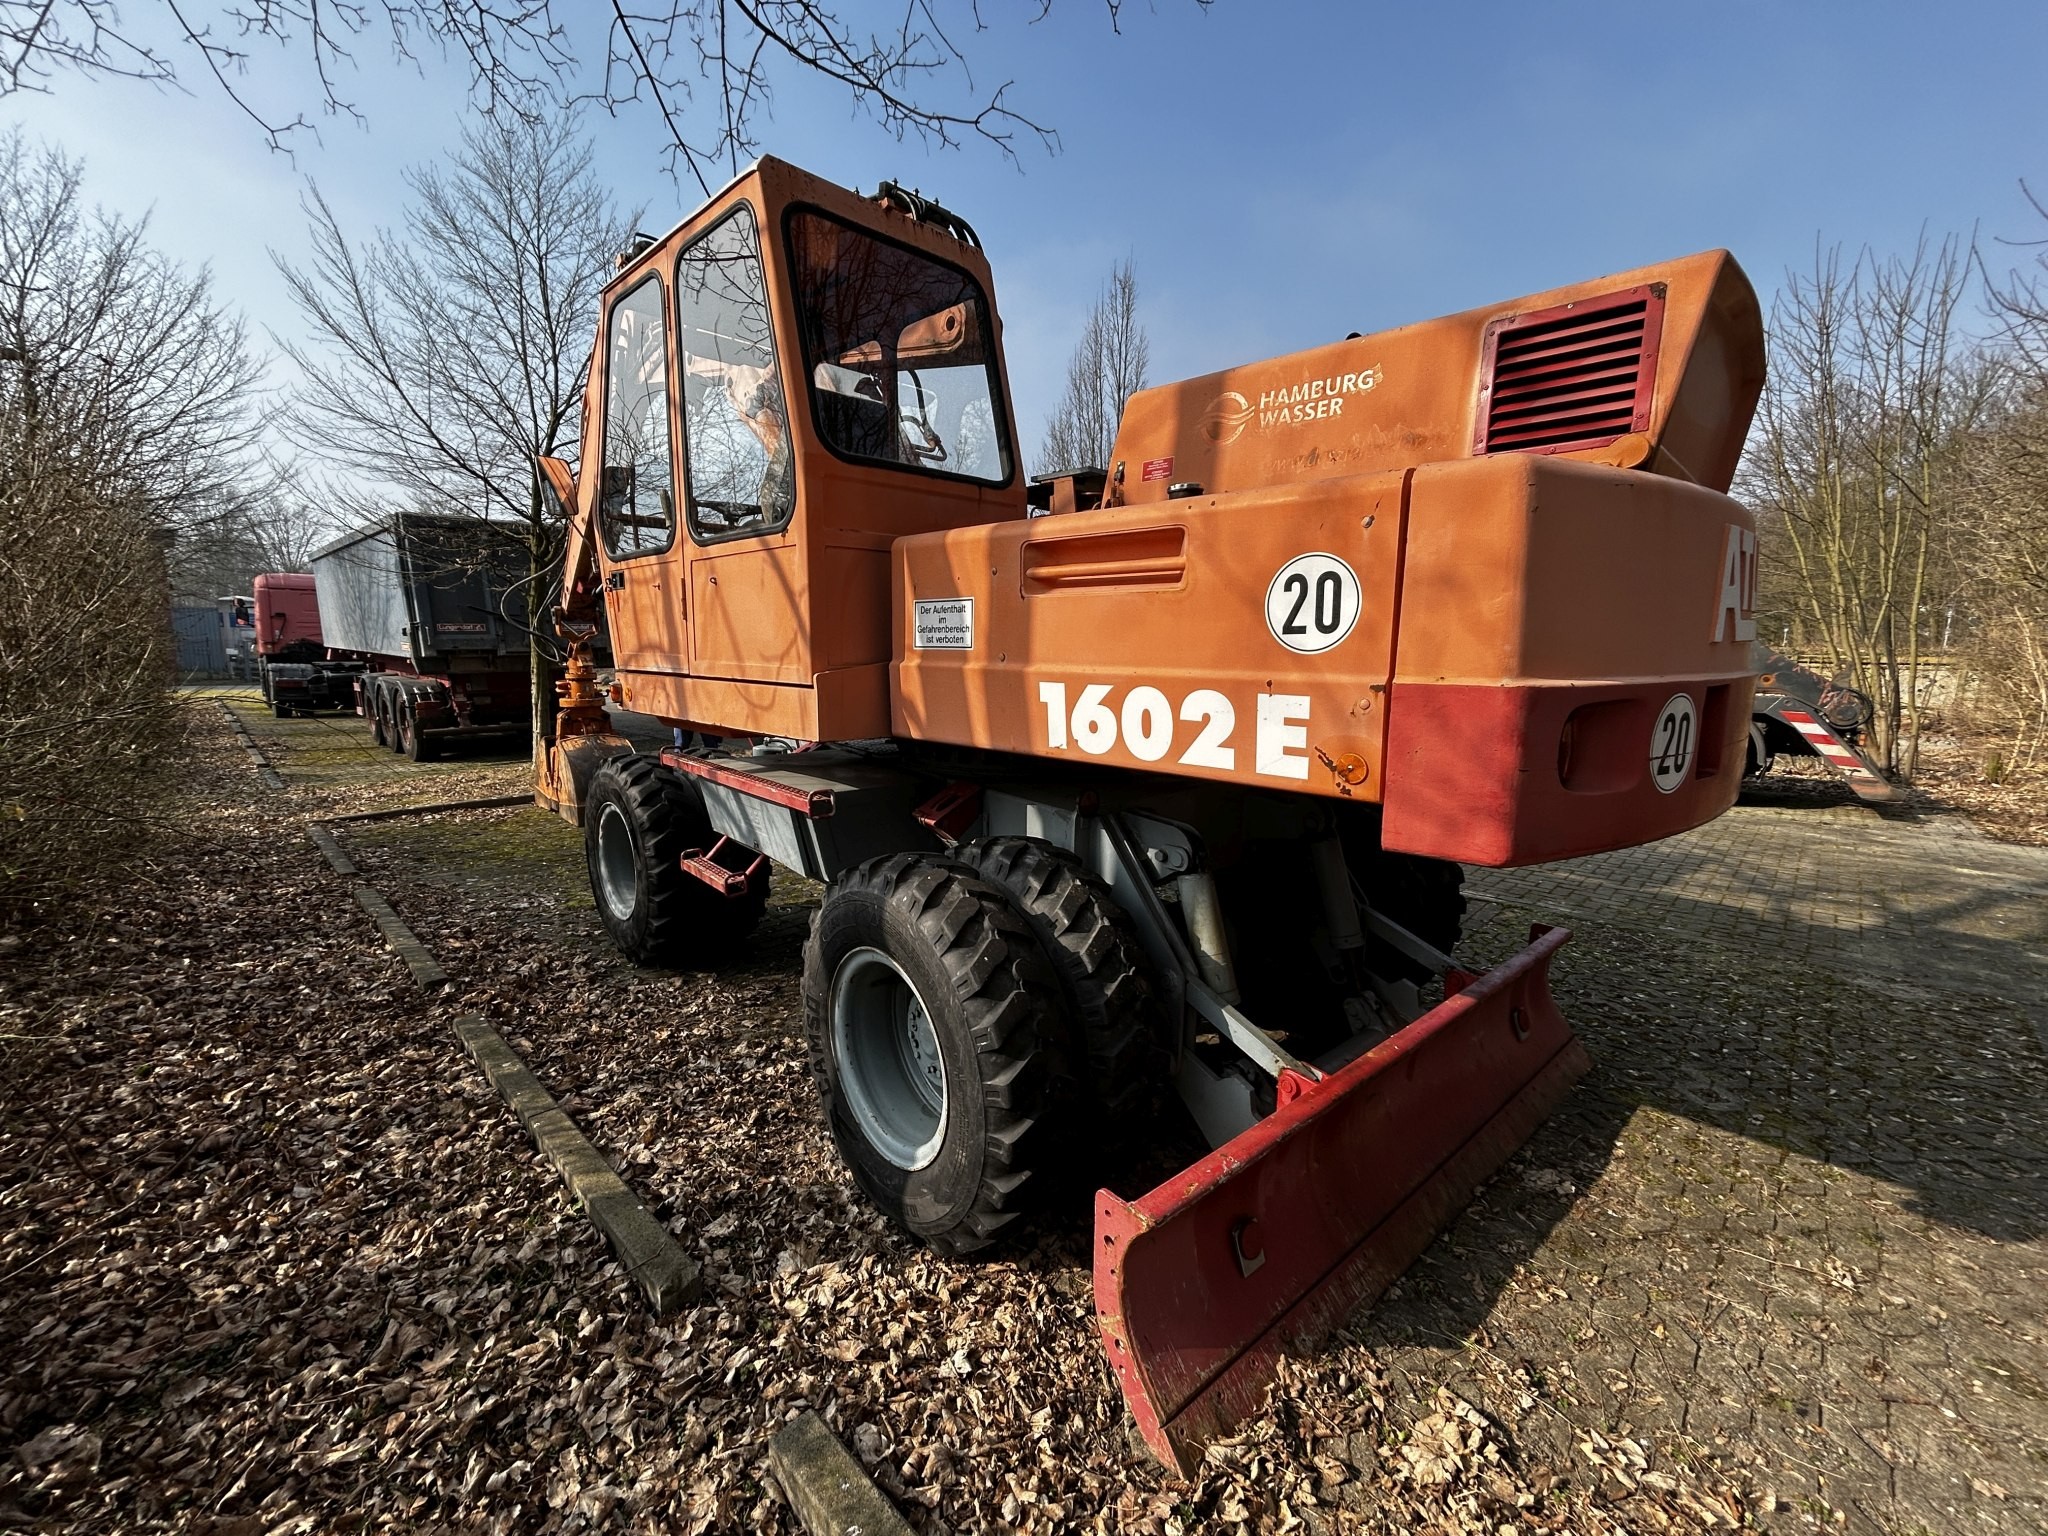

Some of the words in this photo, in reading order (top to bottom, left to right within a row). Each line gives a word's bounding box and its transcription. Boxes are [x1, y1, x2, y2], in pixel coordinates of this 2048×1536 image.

[1260, 370, 1374, 409] HAMBURG
[1260, 398, 1344, 428] WASSER
[920, 606, 931, 614] Der
[933, 604, 966, 614] Aufenthalt
[938, 615, 947, 624] im
[1282, 571, 1342, 635] 20
[917, 624, 970, 633] Gefahrenbereich
[926, 635, 934, 643] ist
[936, 635, 964, 643] verboten
[1039, 681, 1235, 771] 1602
[1255, 693, 1311, 780] E
[1656, 712, 1691, 776] 20
[805, 992, 832, 1097] CAMSO
